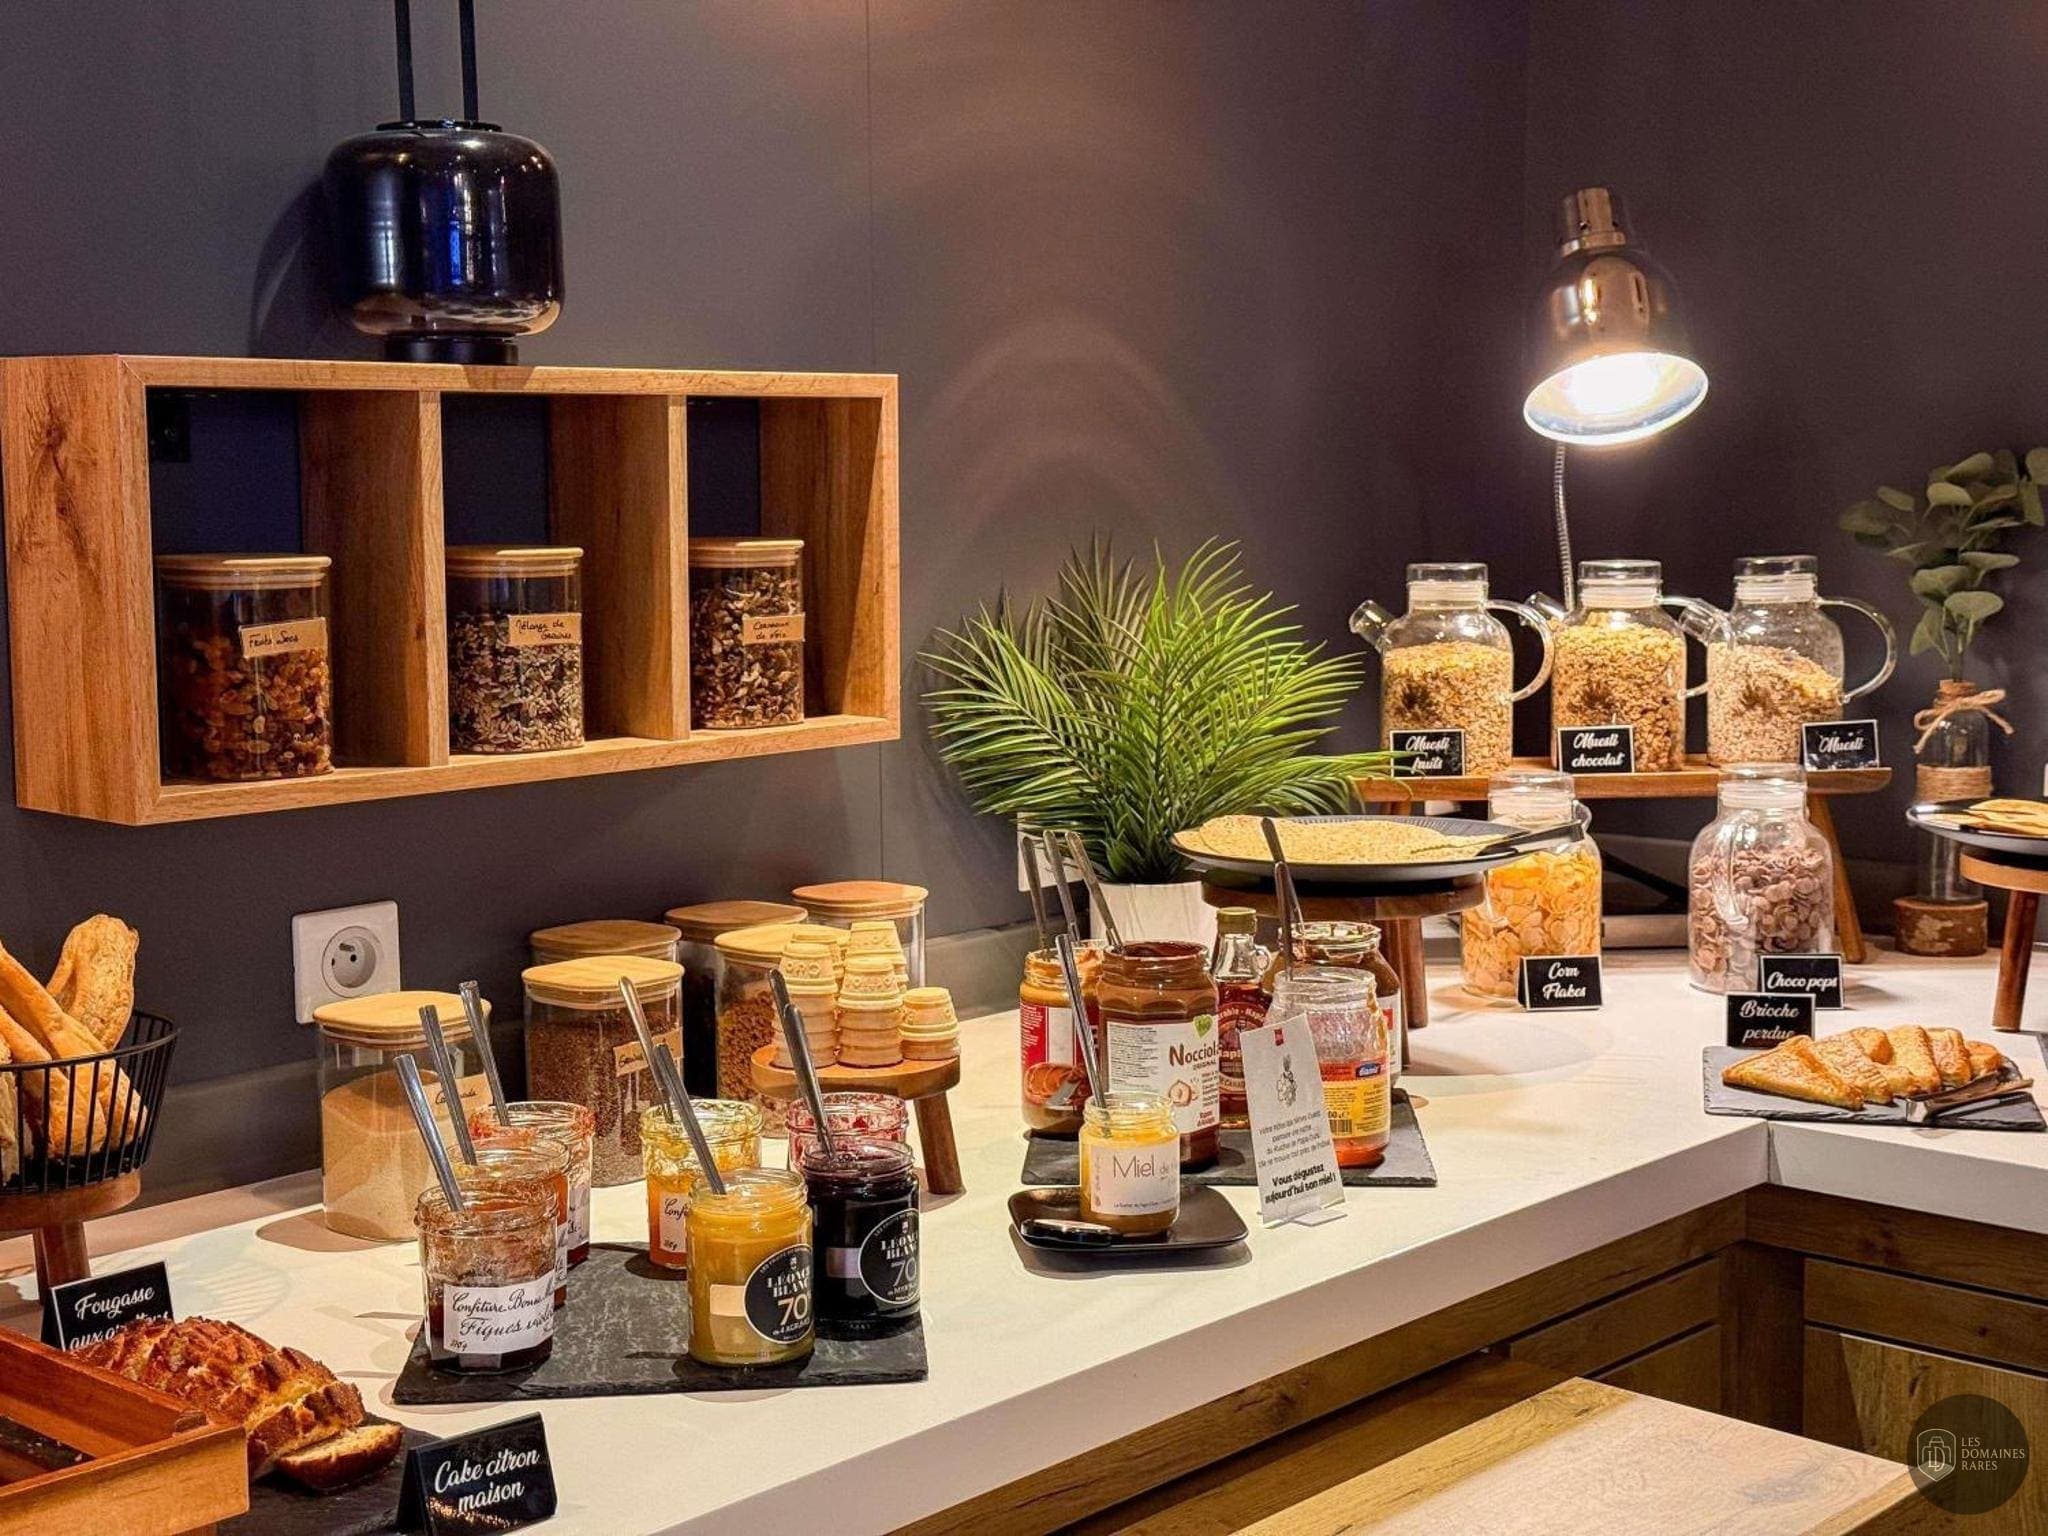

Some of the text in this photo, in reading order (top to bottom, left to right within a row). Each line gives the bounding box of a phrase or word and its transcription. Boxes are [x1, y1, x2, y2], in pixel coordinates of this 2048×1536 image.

[1406, 736, 1450, 754] Muesli
[1573, 732, 1619, 749] Muesli
[1819, 736, 1864, 753] Muesli
[1410, 756, 1443, 774] fruits
[1571, 752, 1625, 767] chocolat
[1548, 962, 1579, 979] Corn
[1542, 982, 1586, 1000] Flakes
[1767, 971, 1837, 992] Choco pops
[1740, 1000, 1800, 1018] Brioche
[1113, 1154, 1154, 1178] Miel
[1272, 1164, 1324, 1187] Vous dégustez
[1265, 1181, 1304, 1204] aujourd'hui
[1305, 1180, 1319, 1191] son
[1319, 1172, 1332, 1186] miel
[664, 1198, 691, 1220] Confi
[74, 1287, 156, 1320] Fougasse
[453, 1292, 508, 1316] Confiture
[459, 1317, 522, 1341] Figues
[434, 1448, 540, 1493] Cake citron
[458, 1481, 525, 1516] maison
